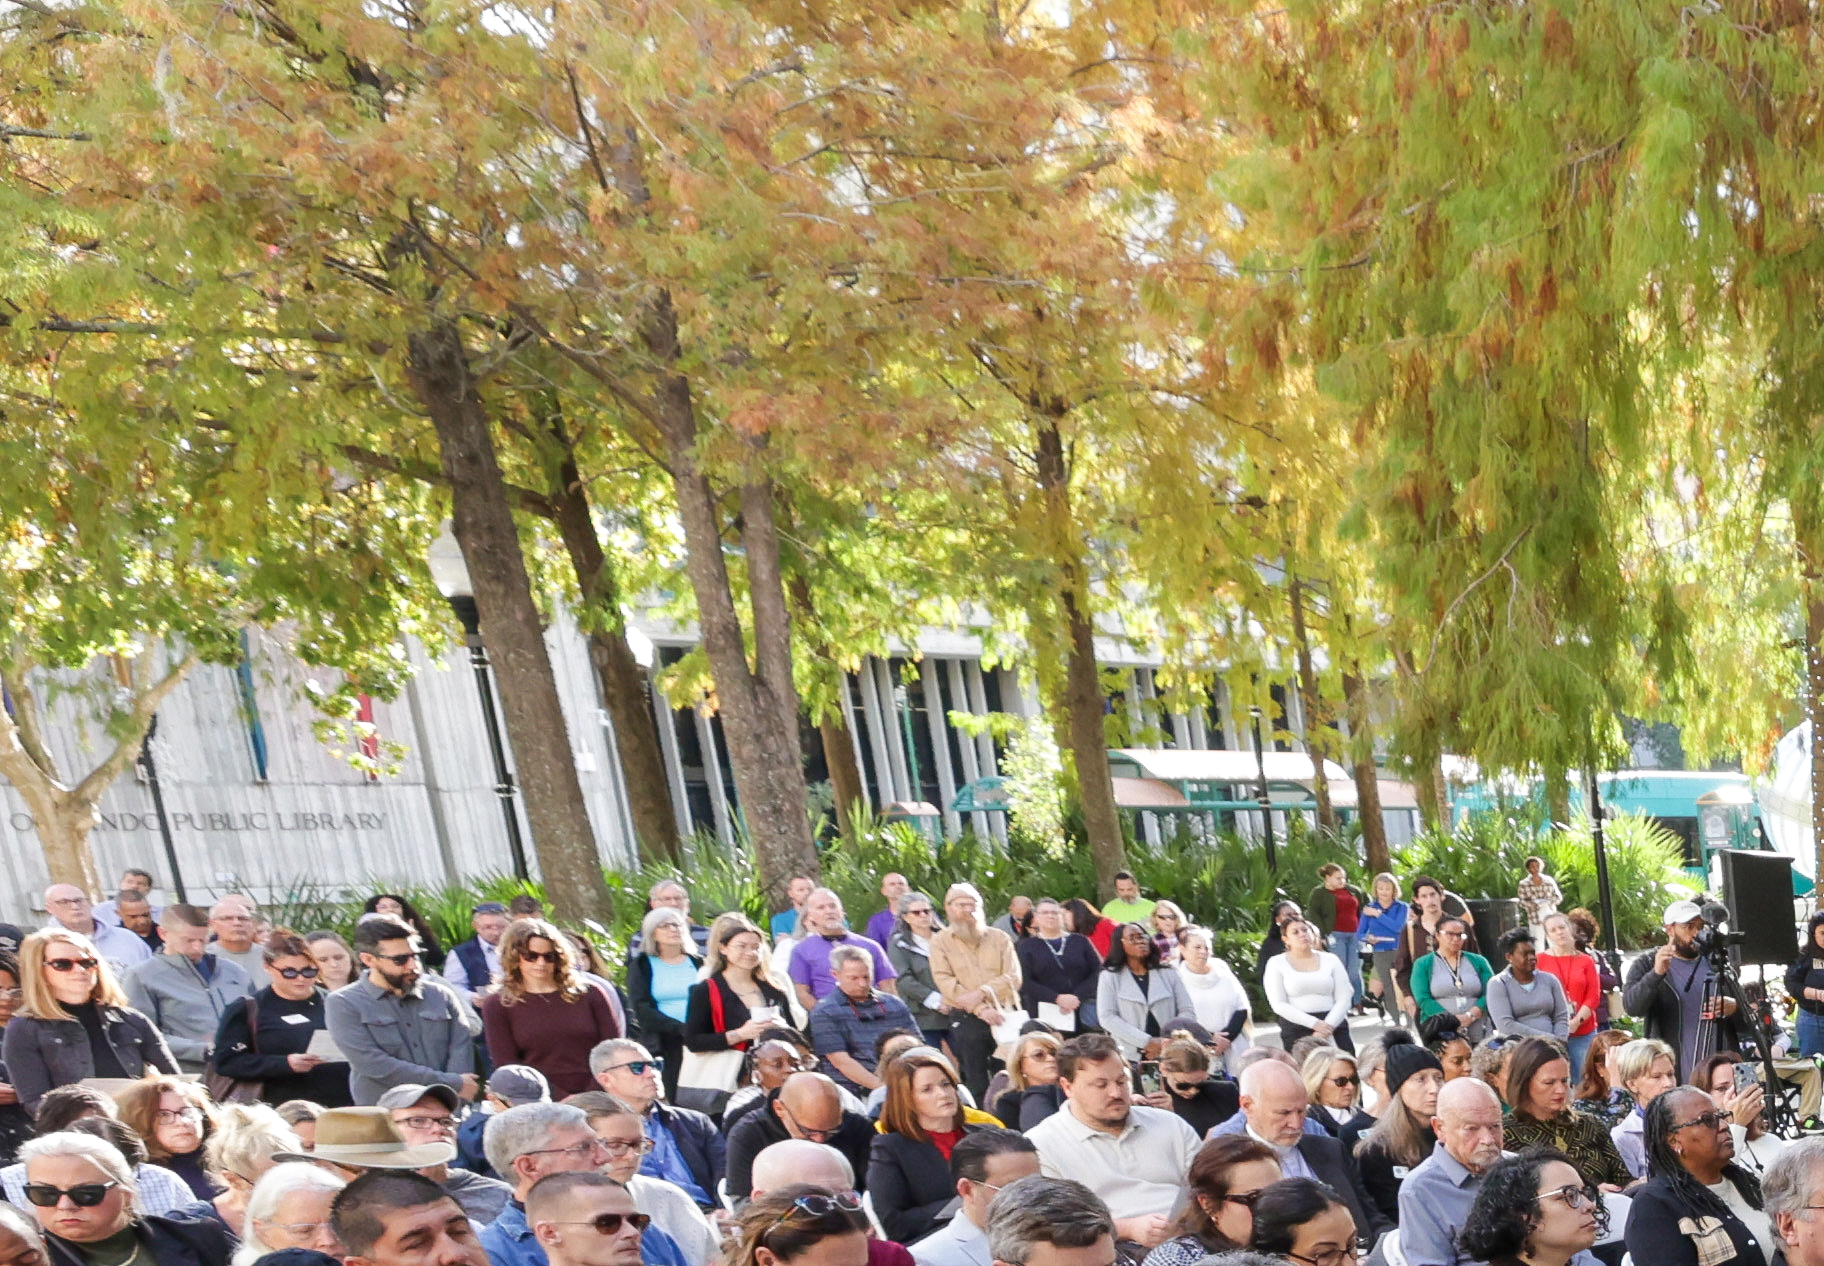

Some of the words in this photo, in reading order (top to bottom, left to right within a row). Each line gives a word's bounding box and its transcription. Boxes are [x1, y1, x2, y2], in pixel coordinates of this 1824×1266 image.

[10, 812, 161, 832] ONDO
[173, 812, 270, 832] PUBLIC
[278, 812, 387, 832] LIBRARY
